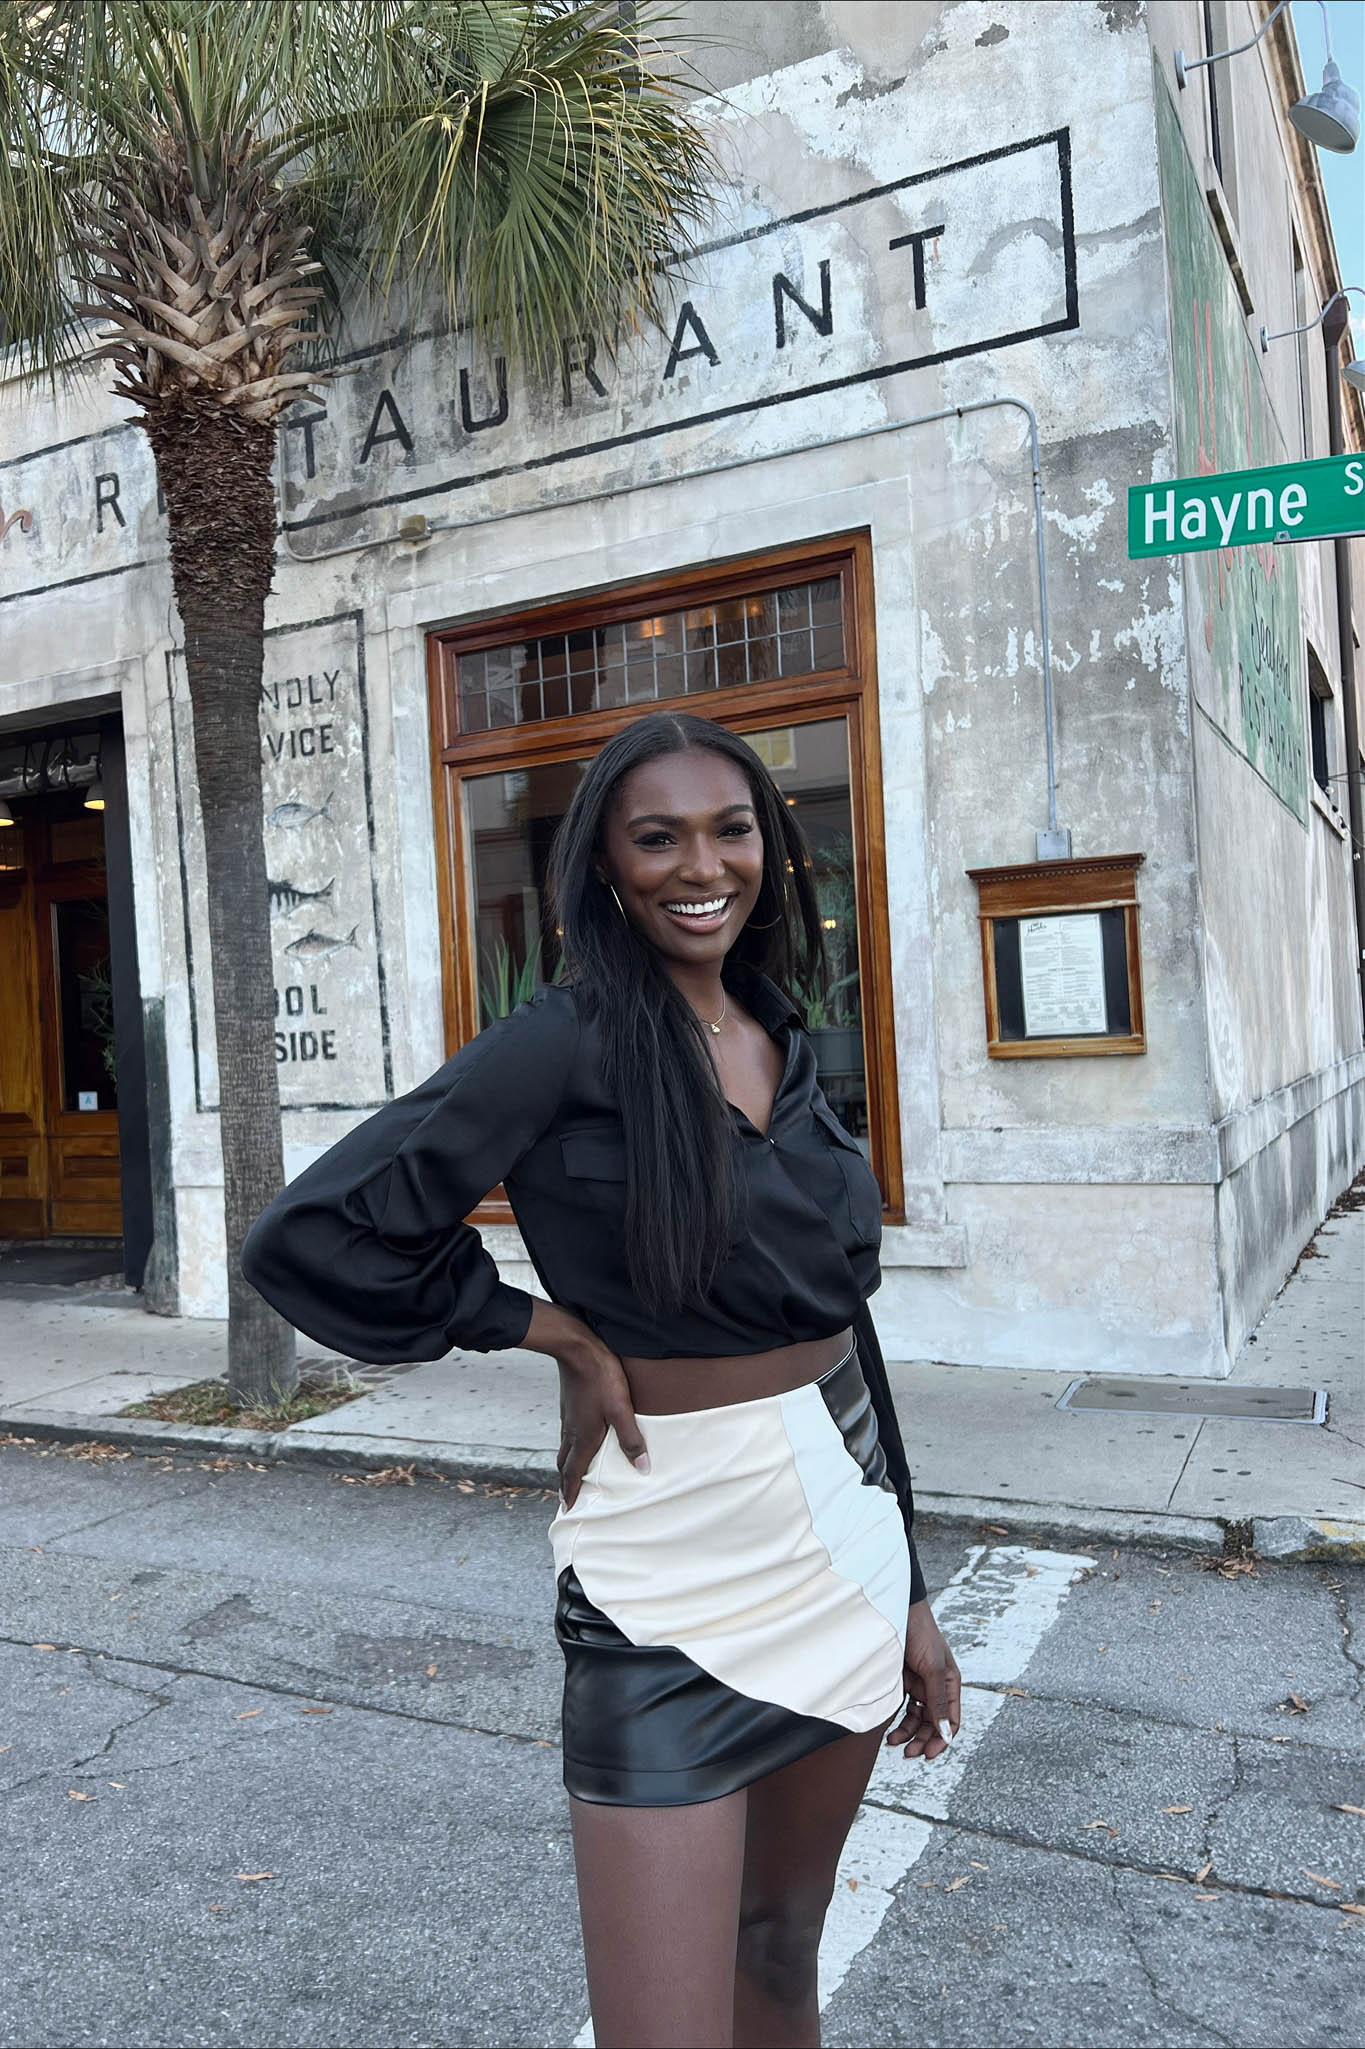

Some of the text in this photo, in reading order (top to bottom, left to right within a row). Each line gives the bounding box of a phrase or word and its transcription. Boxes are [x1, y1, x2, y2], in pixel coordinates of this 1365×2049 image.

[95, 223, 946, 534] RTAURANT
[1144, 461, 1364, 546] Hayne S
[260, 669, 340, 714] NDLY
[264, 723, 335, 762] VICE
[273, 984, 328, 1018] OL
[274, 1029, 337, 1063] SIDE
